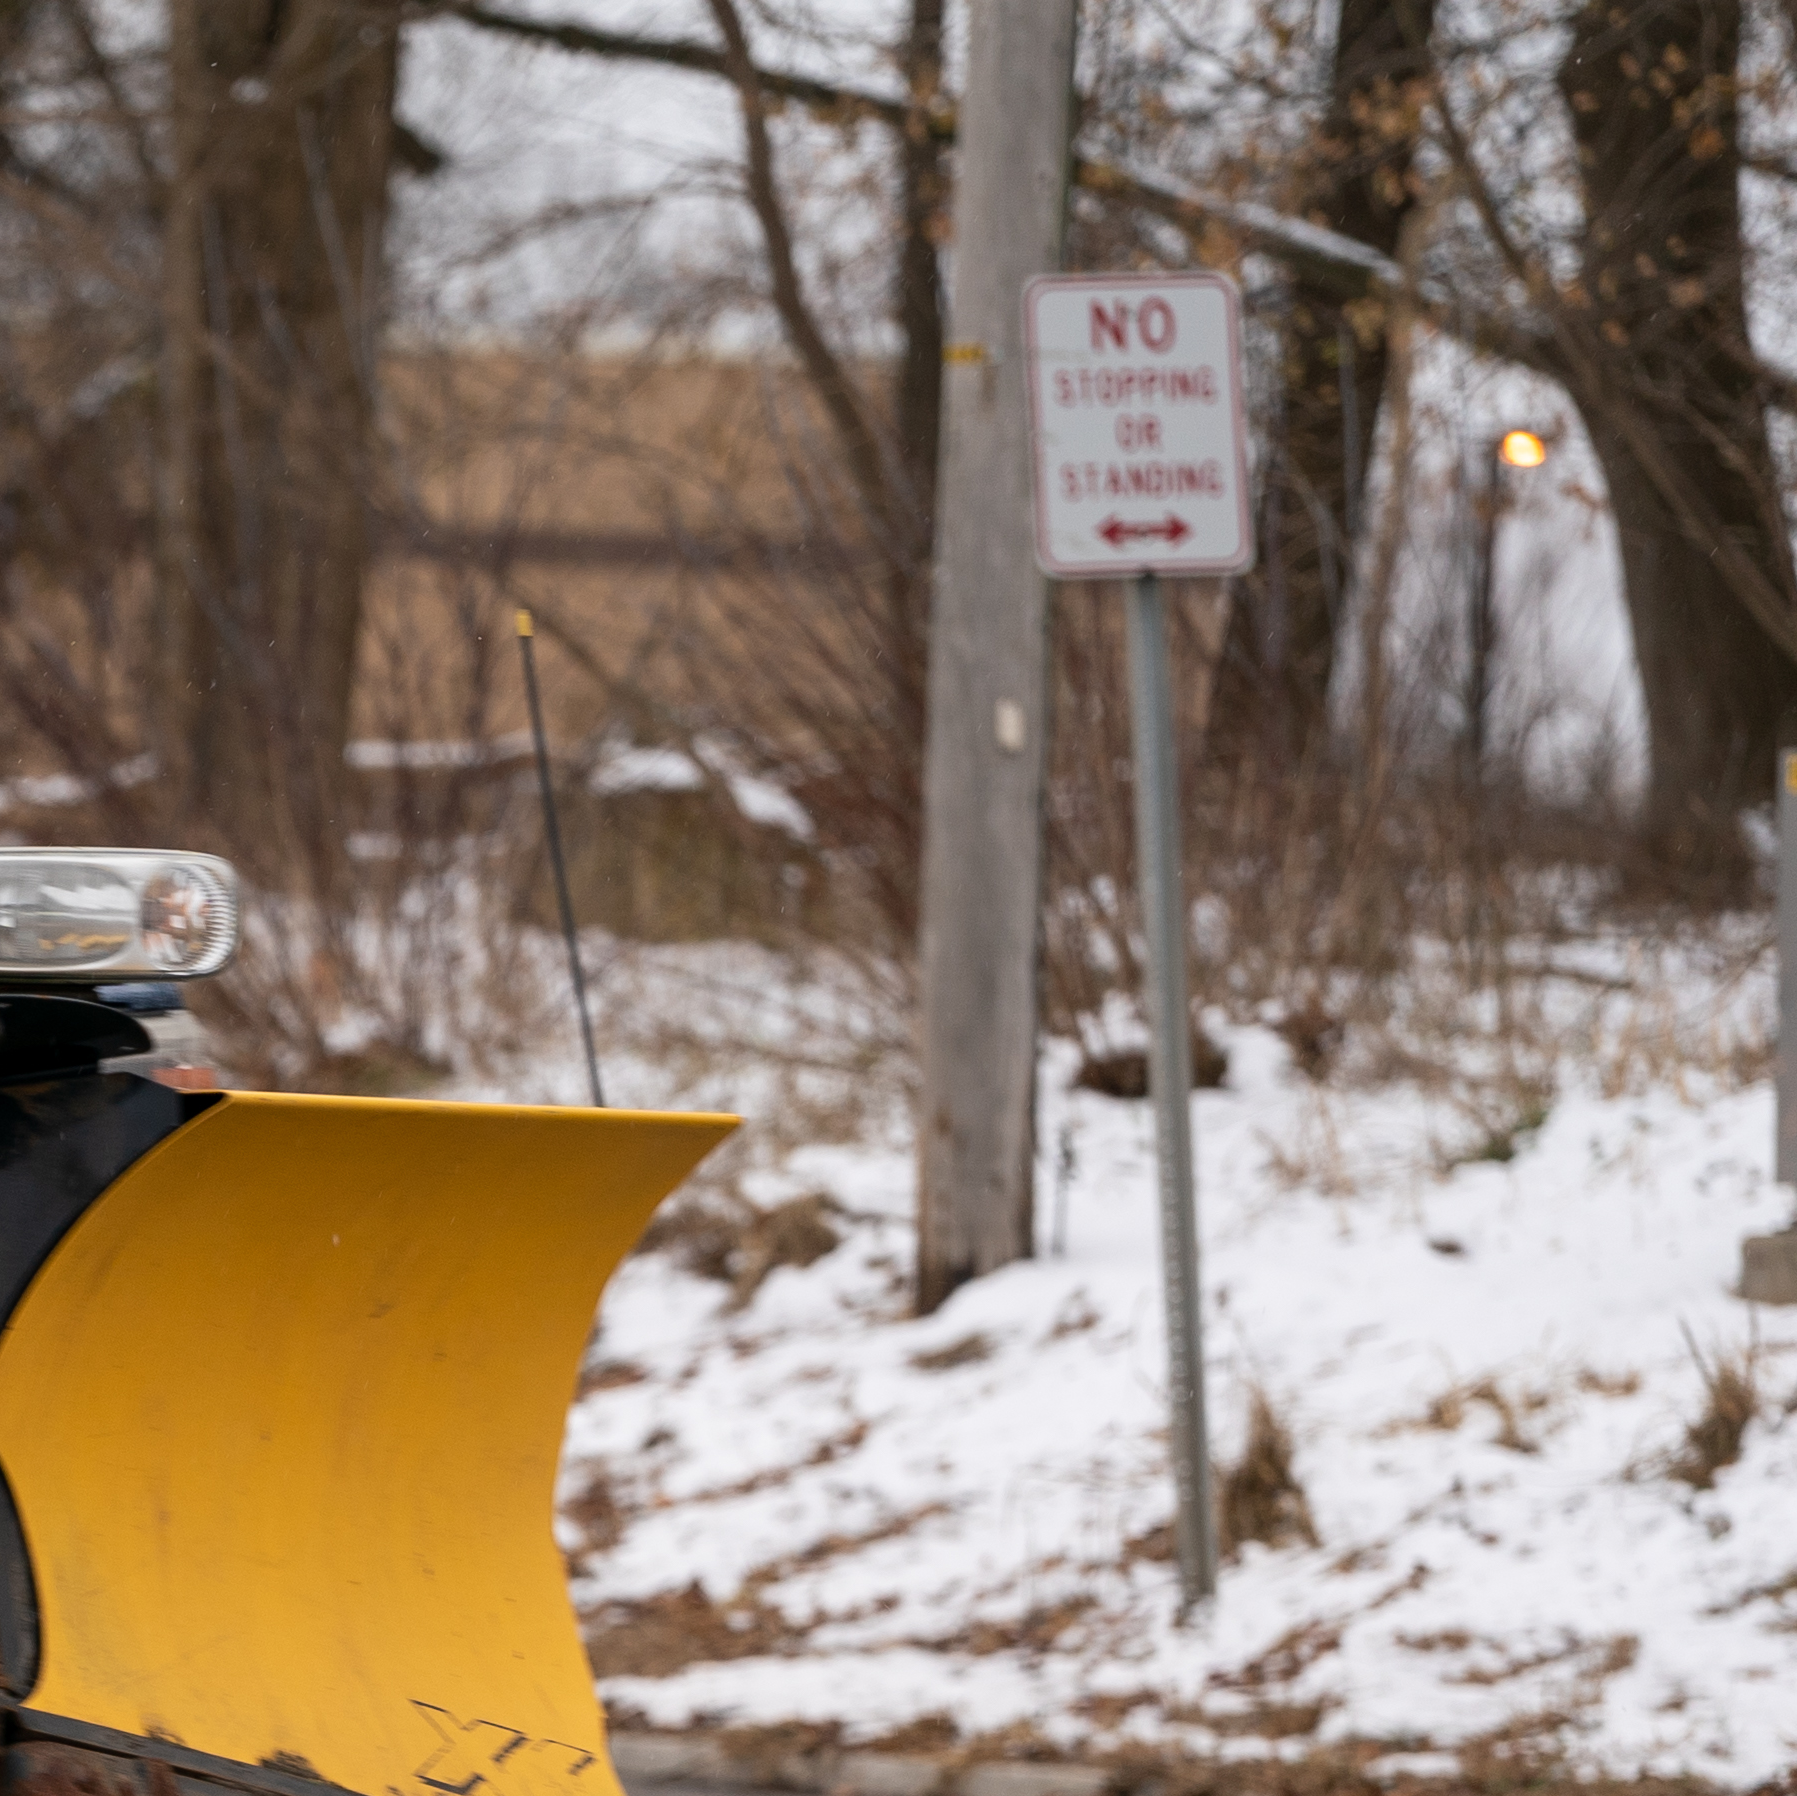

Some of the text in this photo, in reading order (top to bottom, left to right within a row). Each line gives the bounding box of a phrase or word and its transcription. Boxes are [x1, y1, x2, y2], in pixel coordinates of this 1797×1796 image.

[1089, 296, 1177, 354] NO
[1055, 366, 1217, 406] STOPPING
[1114, 413, 1163, 452] OR
[1059, 459, 1224, 501] STANDING
